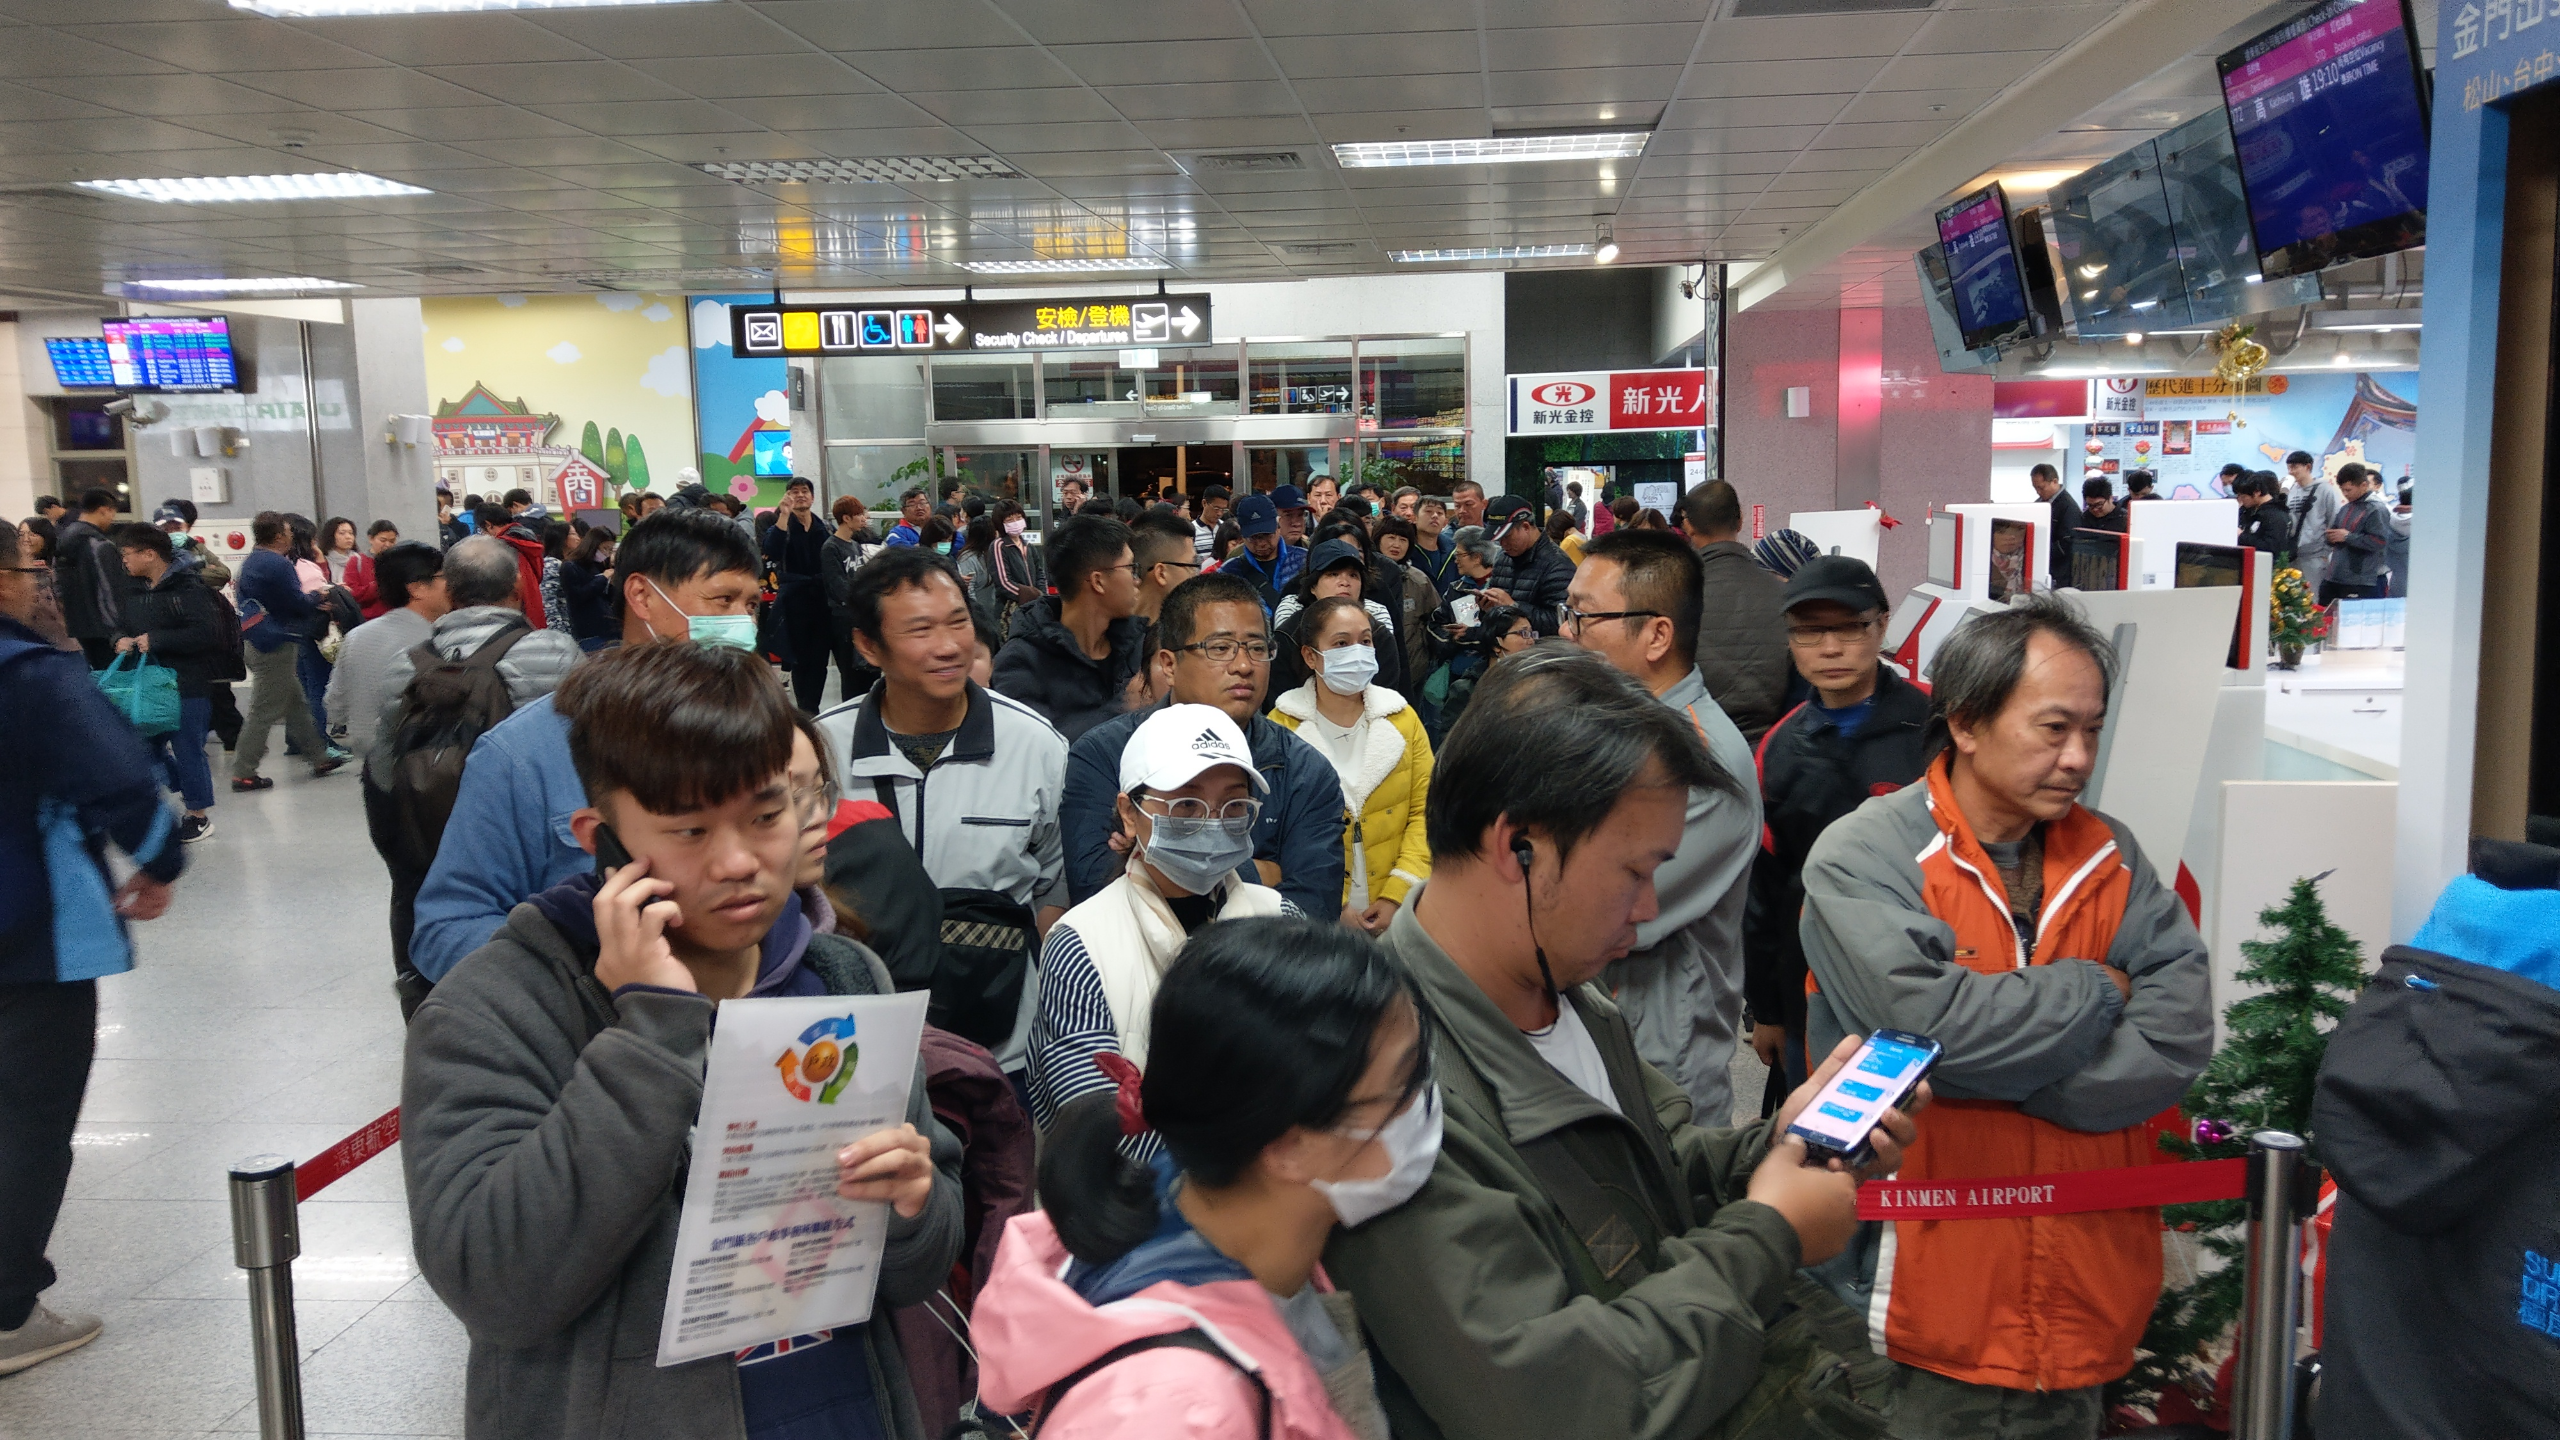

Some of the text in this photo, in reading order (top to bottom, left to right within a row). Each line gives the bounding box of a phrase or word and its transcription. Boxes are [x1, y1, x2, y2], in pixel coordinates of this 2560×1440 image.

[2311, 62, 2339, 92] 19:10
[1035, 304, 1130, 330] 安檢/登機
[975, 331, 1020, 348] Security
[1022, 330, 1058, 345] Check
[1067, 329, 1128, 346] Departures
[1554, 385, 1573, 403] 光
[2106, 397, 2137, 412] 新光金控
[1533, 409, 1595, 425] 新光金控
[1191, 741, 1231, 750] adidas
[1880, 1185, 2055, 1208] KINMEN AIRPORT
